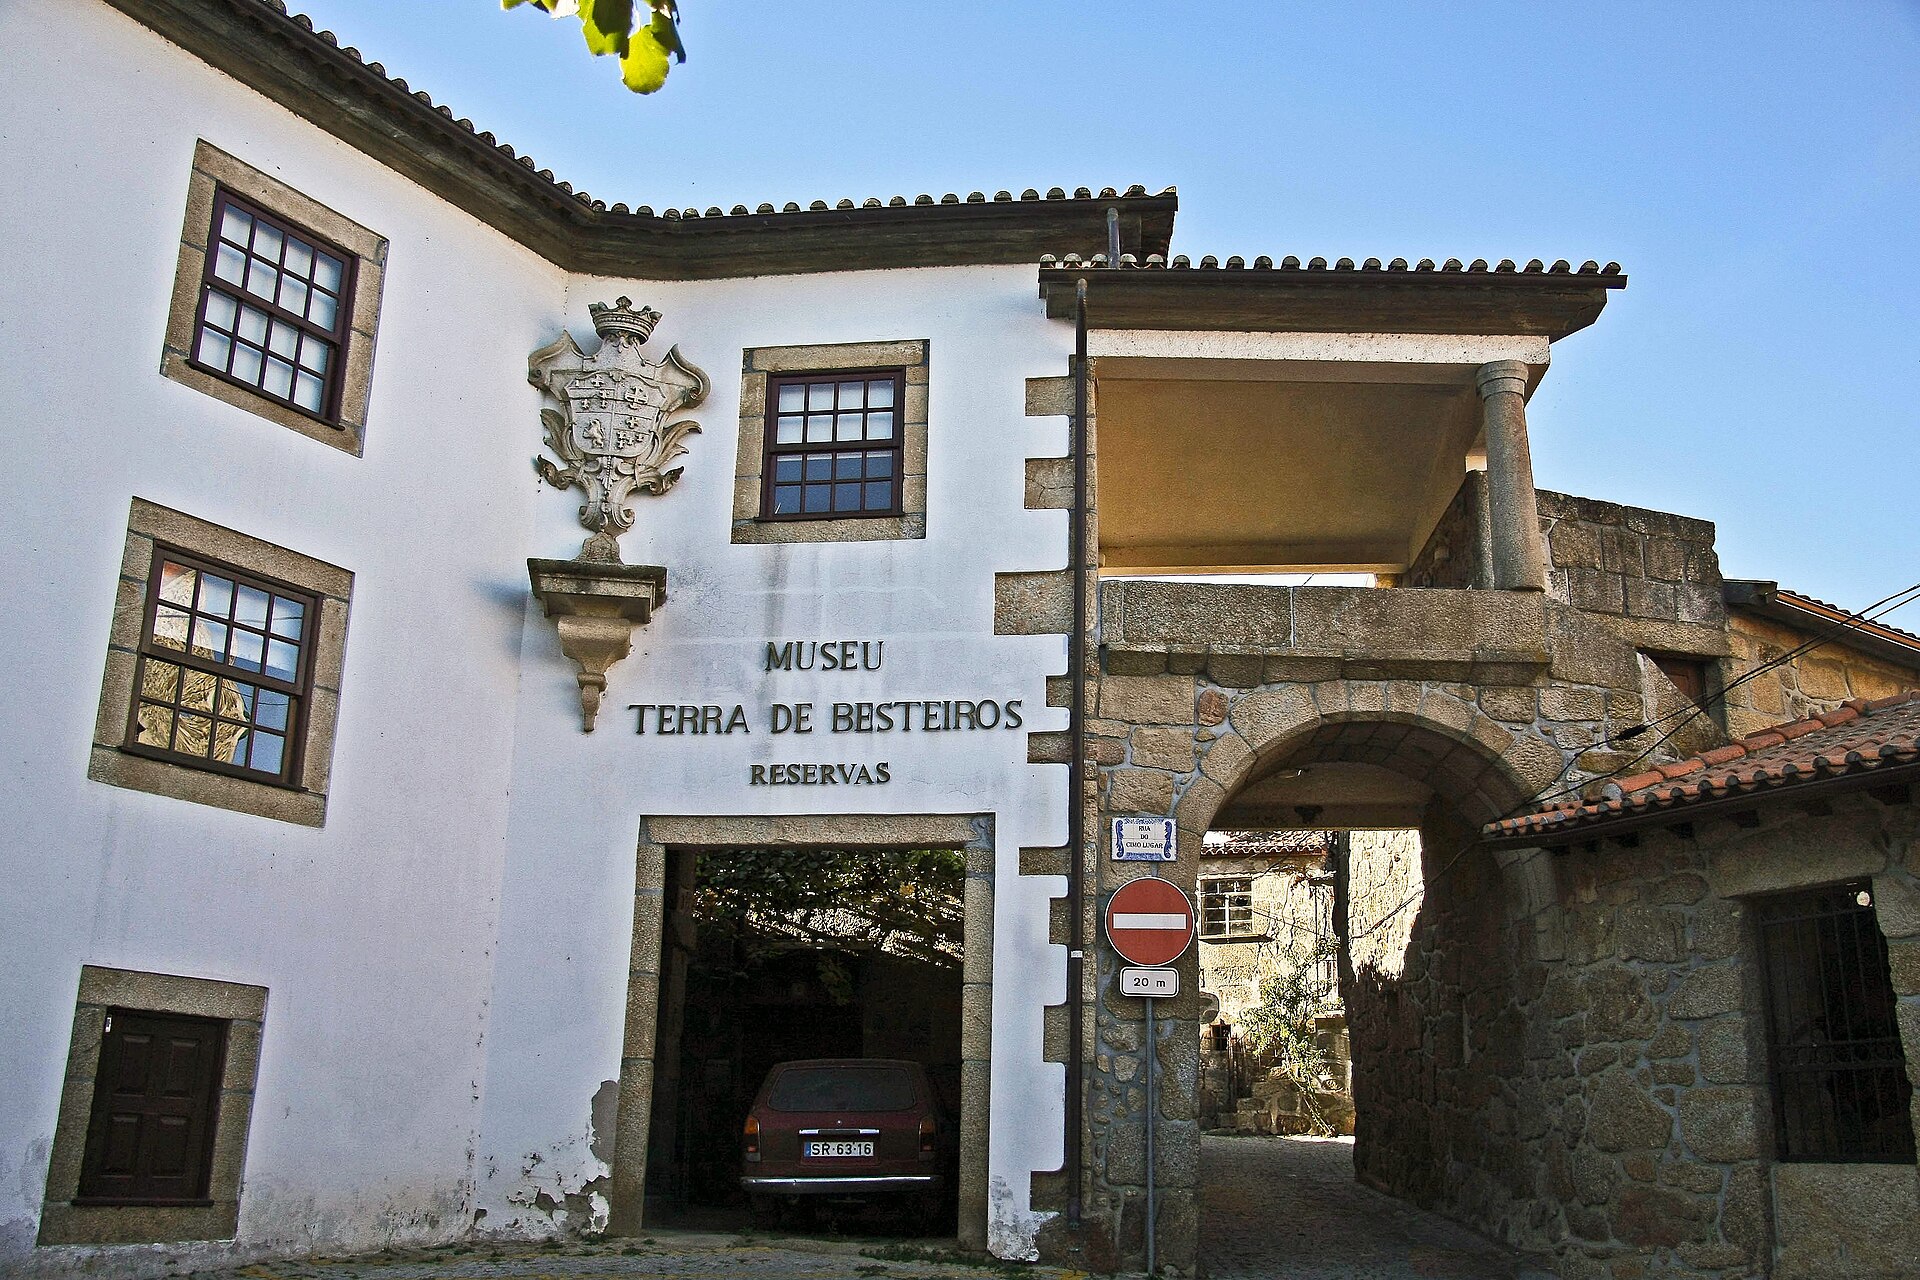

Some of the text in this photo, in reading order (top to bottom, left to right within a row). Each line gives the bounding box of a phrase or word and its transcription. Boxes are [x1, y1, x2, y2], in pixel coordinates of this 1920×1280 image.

[765, 640, 884, 671] MUSEU
[628, 699, 1023, 735] TERRA DE BESTEIROS
[749, 762, 891, 785] RESERVAS
[1133, 977, 1149, 987] 20
